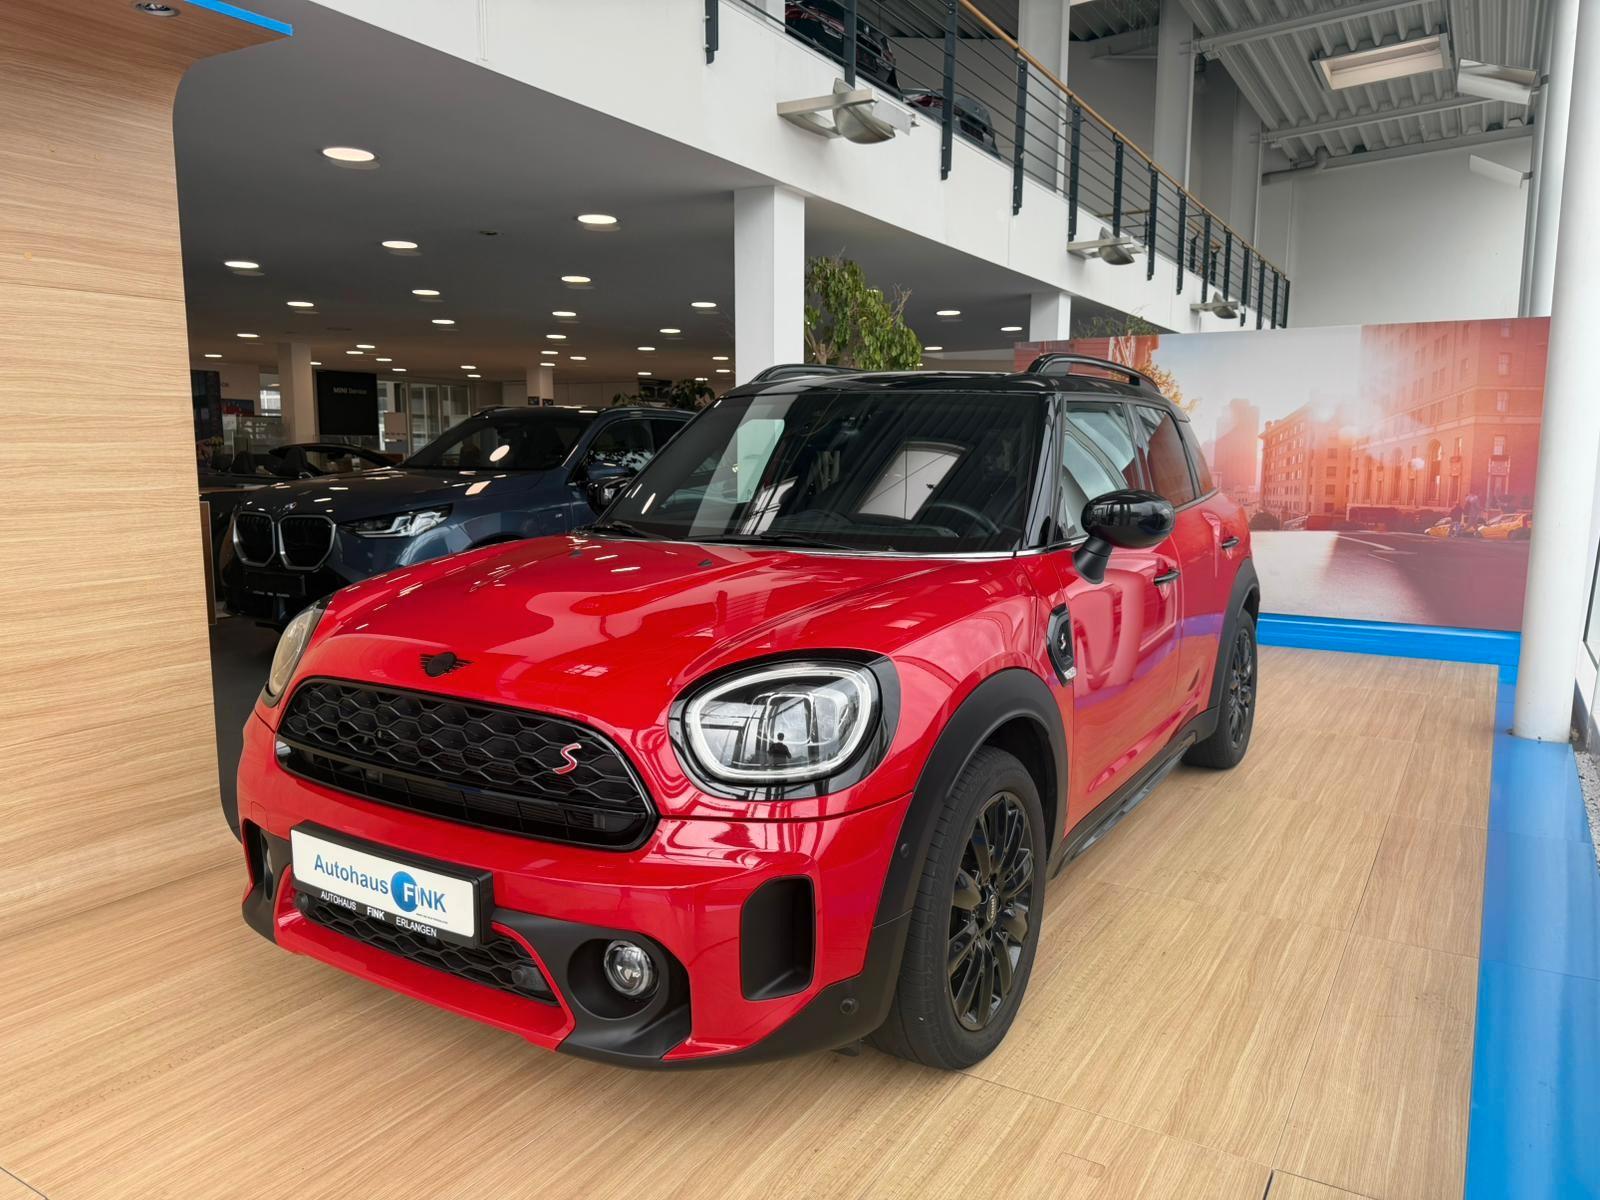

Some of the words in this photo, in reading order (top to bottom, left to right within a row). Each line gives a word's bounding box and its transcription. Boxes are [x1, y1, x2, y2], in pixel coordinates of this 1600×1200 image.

[552, 743, 582, 775] S
[314, 854, 389, 895] Autohaus
[403, 882, 447, 913] FINK
[320, 890, 357, 911] AUTOHAUS
[366, 906, 385, 921] FINK
[395, 916, 437, 937] ERLANGEN
